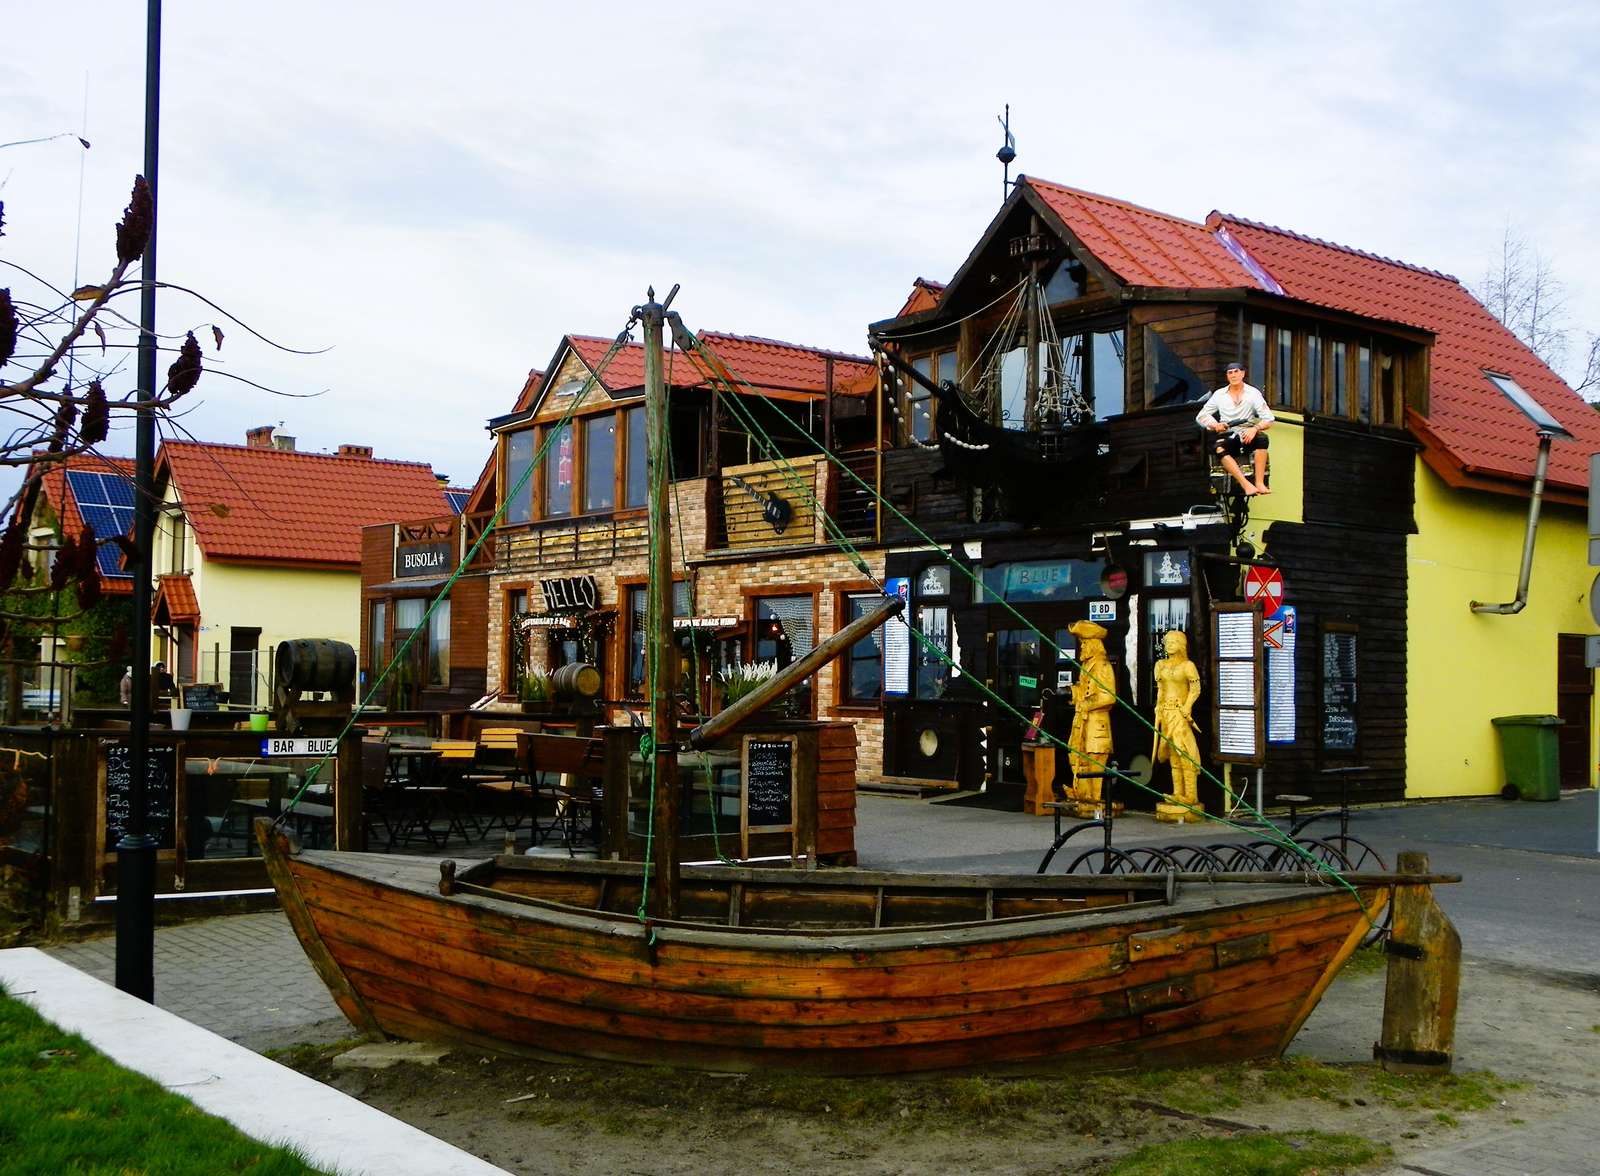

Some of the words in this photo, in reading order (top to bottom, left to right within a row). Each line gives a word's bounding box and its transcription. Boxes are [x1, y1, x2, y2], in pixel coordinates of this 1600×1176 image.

[405, 552, 438, 568] BUSOLA
[1020, 567, 1059, 584] BLUE
[540, 576, 595, 610] HELLO
[1099, 604, 1110, 614] 8D
[273, 740, 294, 753] BAR
[307, 739, 332, 752] BLUE
